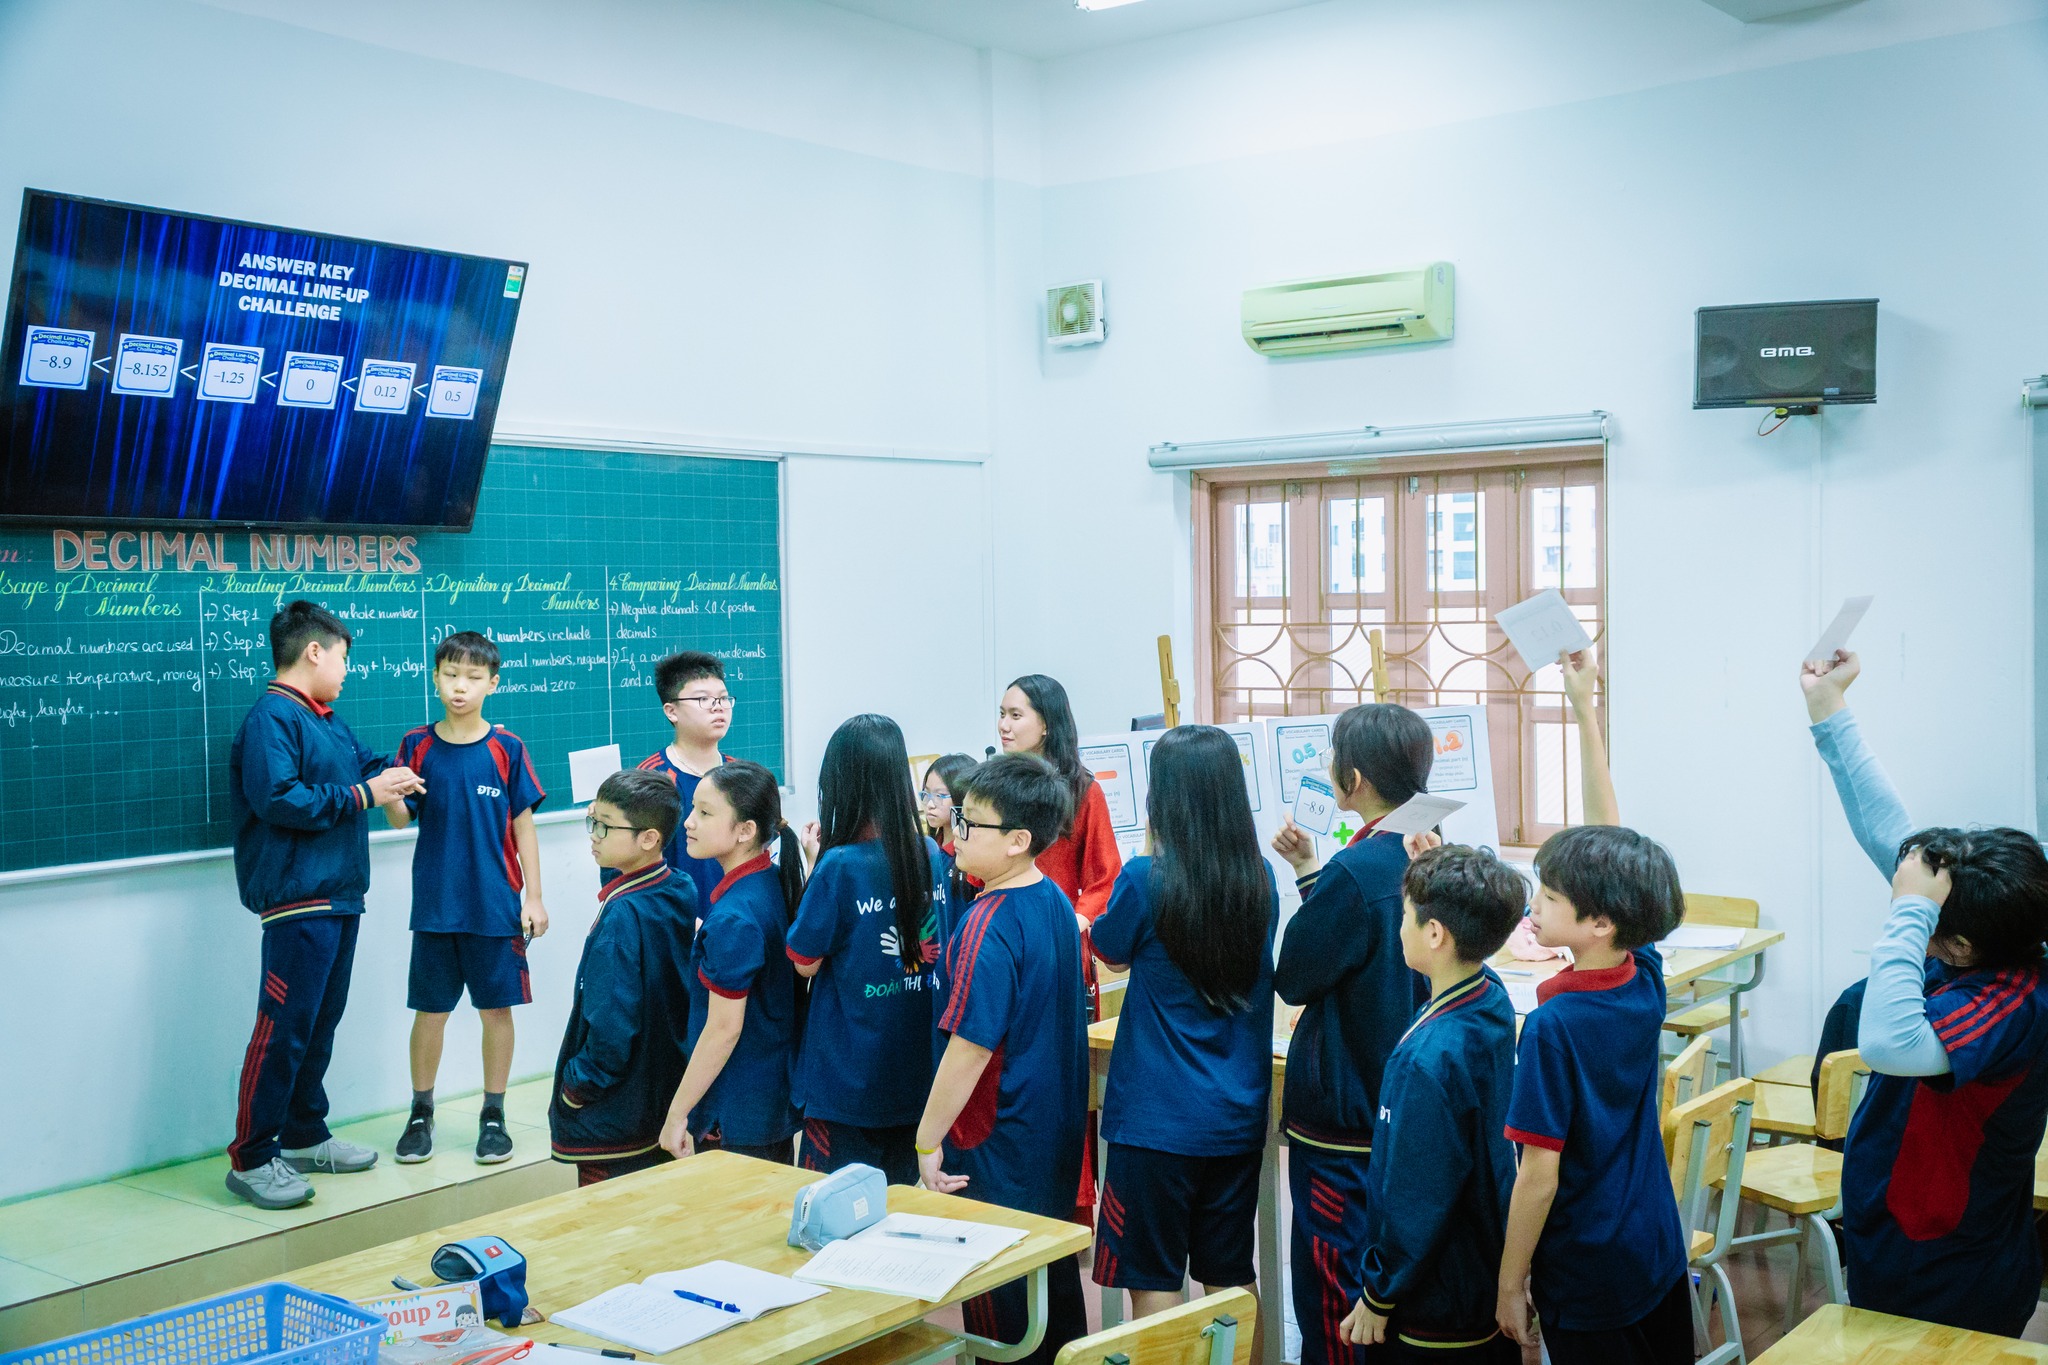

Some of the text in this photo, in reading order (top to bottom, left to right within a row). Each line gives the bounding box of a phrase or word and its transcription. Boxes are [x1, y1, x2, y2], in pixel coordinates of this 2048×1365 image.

[239, 253, 354, 281] ANSWER KEY
[219, 271, 369, 303] DECIMAL LINE-UP
[238, 296, 342, 321] CHALLENGE
[39, 355, 72, 369] -8.9
[124, 362, 168, 377] -8.152
[213, 371, 245, 384] -1.25
[306, 379, 315, 390] 0
[373, 385, 397, 398] 0.12
[445, 390, 461, 402] 0.5
[53, 529, 421, 574] DECIMAL NUMBERS
[71, 573, 159, 595] Decimal
[217, 573, 286, 606] Reading
[287, 574, 351, 593] Decimal
[351, 574, 416, 593] Numbers
[434, 572, 500, 606] Definition
[515, 572, 572, 592] Decimal
[618, 571, 682, 603] Comparing
[683, 570, 736, 591] Decimal
[734, 572, 778, 591] Numbers
[85, 594, 182, 616] Numbers
[339, 603, 375, 619] whole
[378, 604, 419, 619] number
[541, 591, 600, 611] Numbers
[621, 601, 658, 622] Negative
[661, 600, 699, 615] decimals
[727, 601, 757, 619] positive
[497, 626, 546, 643] numbers
[548, 625, 591, 641] include
[616, 622, 657, 639] decimals
[0, 629, 193, 656] Decimal numbers are used
[223, 631, 253, 657] Step
[731, 643, 767, 659] decimals
[163, 670, 202, 692] money
[228, 659, 256, 685] Step
[261, 661, 271, 677] 3
[383, 656, 401, 677] by
[620, 671, 641, 687] and
[530, 677, 548, 693] and
[549, 680, 576, 692] zero
[1292, 742, 1317, 764] 0.5
[1303, 801, 1325, 816] -8.9
[856, 897, 883, 915] We
[436, 1299, 451, 1319] 2
